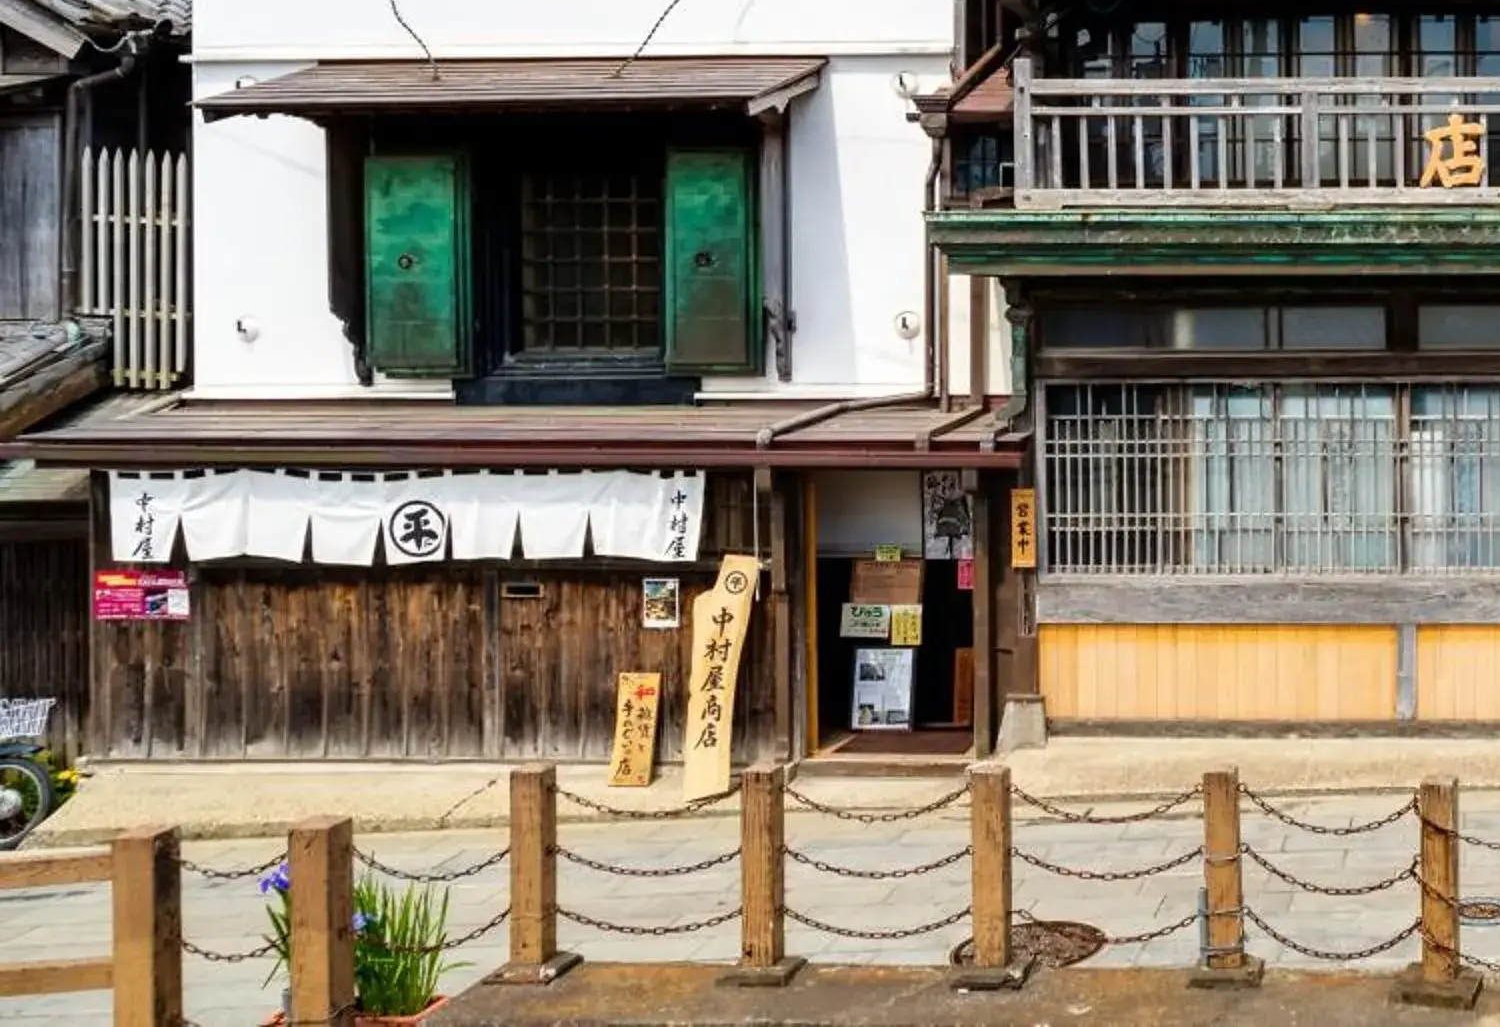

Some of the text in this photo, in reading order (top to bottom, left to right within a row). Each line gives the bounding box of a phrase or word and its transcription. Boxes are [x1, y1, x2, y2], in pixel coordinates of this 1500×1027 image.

[132, 491, 155, 559] 中村屋
[663, 489, 688, 559] 中村屋
[1016, 502, 1030, 555] 営業中
[694, 606, 735, 751] 中村屋商店
